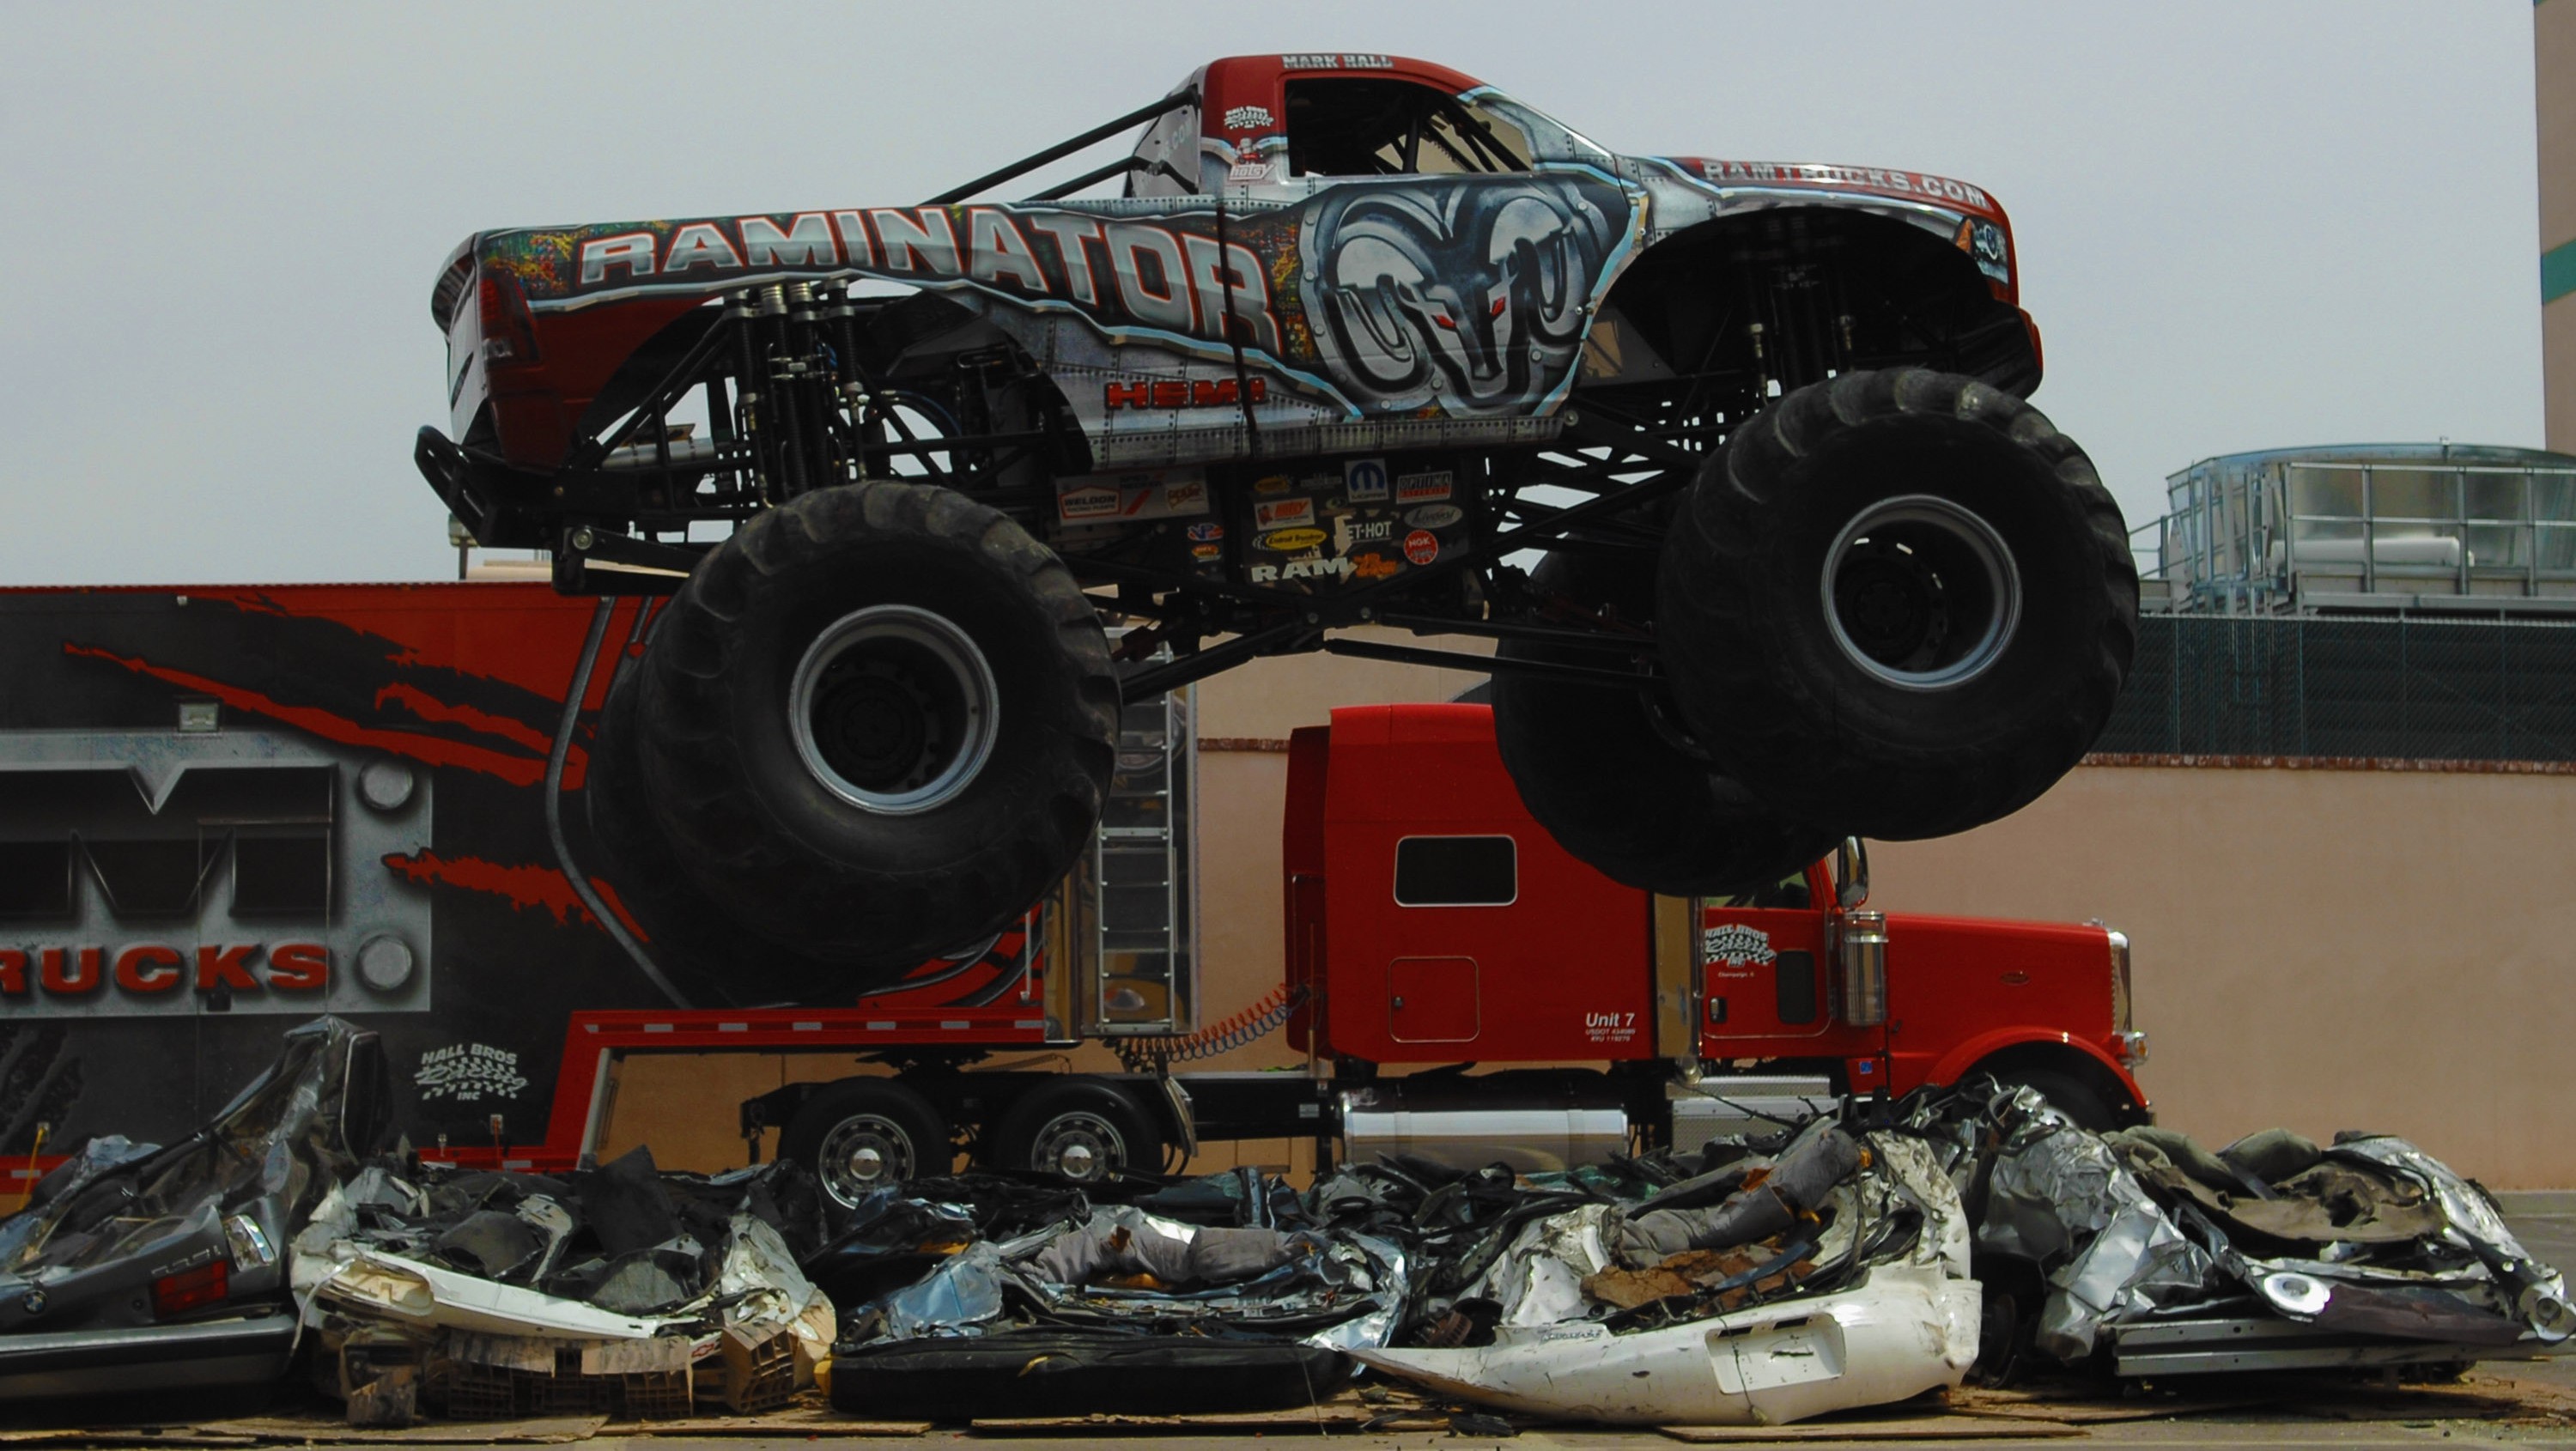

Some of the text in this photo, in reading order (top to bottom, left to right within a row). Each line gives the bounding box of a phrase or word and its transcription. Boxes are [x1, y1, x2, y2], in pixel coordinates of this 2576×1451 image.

[1282, 54, 1394, 69] MARK HALL
[1700, 159, 1990, 209] RAMTRUCKS.COM
[579, 206, 1281, 357] RAMINATOR
[1105, 377, 1267, 409] HEMI
[1400, 473, 1451, 489] OPTIMA
[1065, 495, 1116, 506] WELDON
[1250, 557, 1347, 583] RAM
[1586, 1012, 1635, 1027] Unit 7
[421, 1043, 517, 1065] HALL BROS
[457, 1091, 481, 1101] INC
